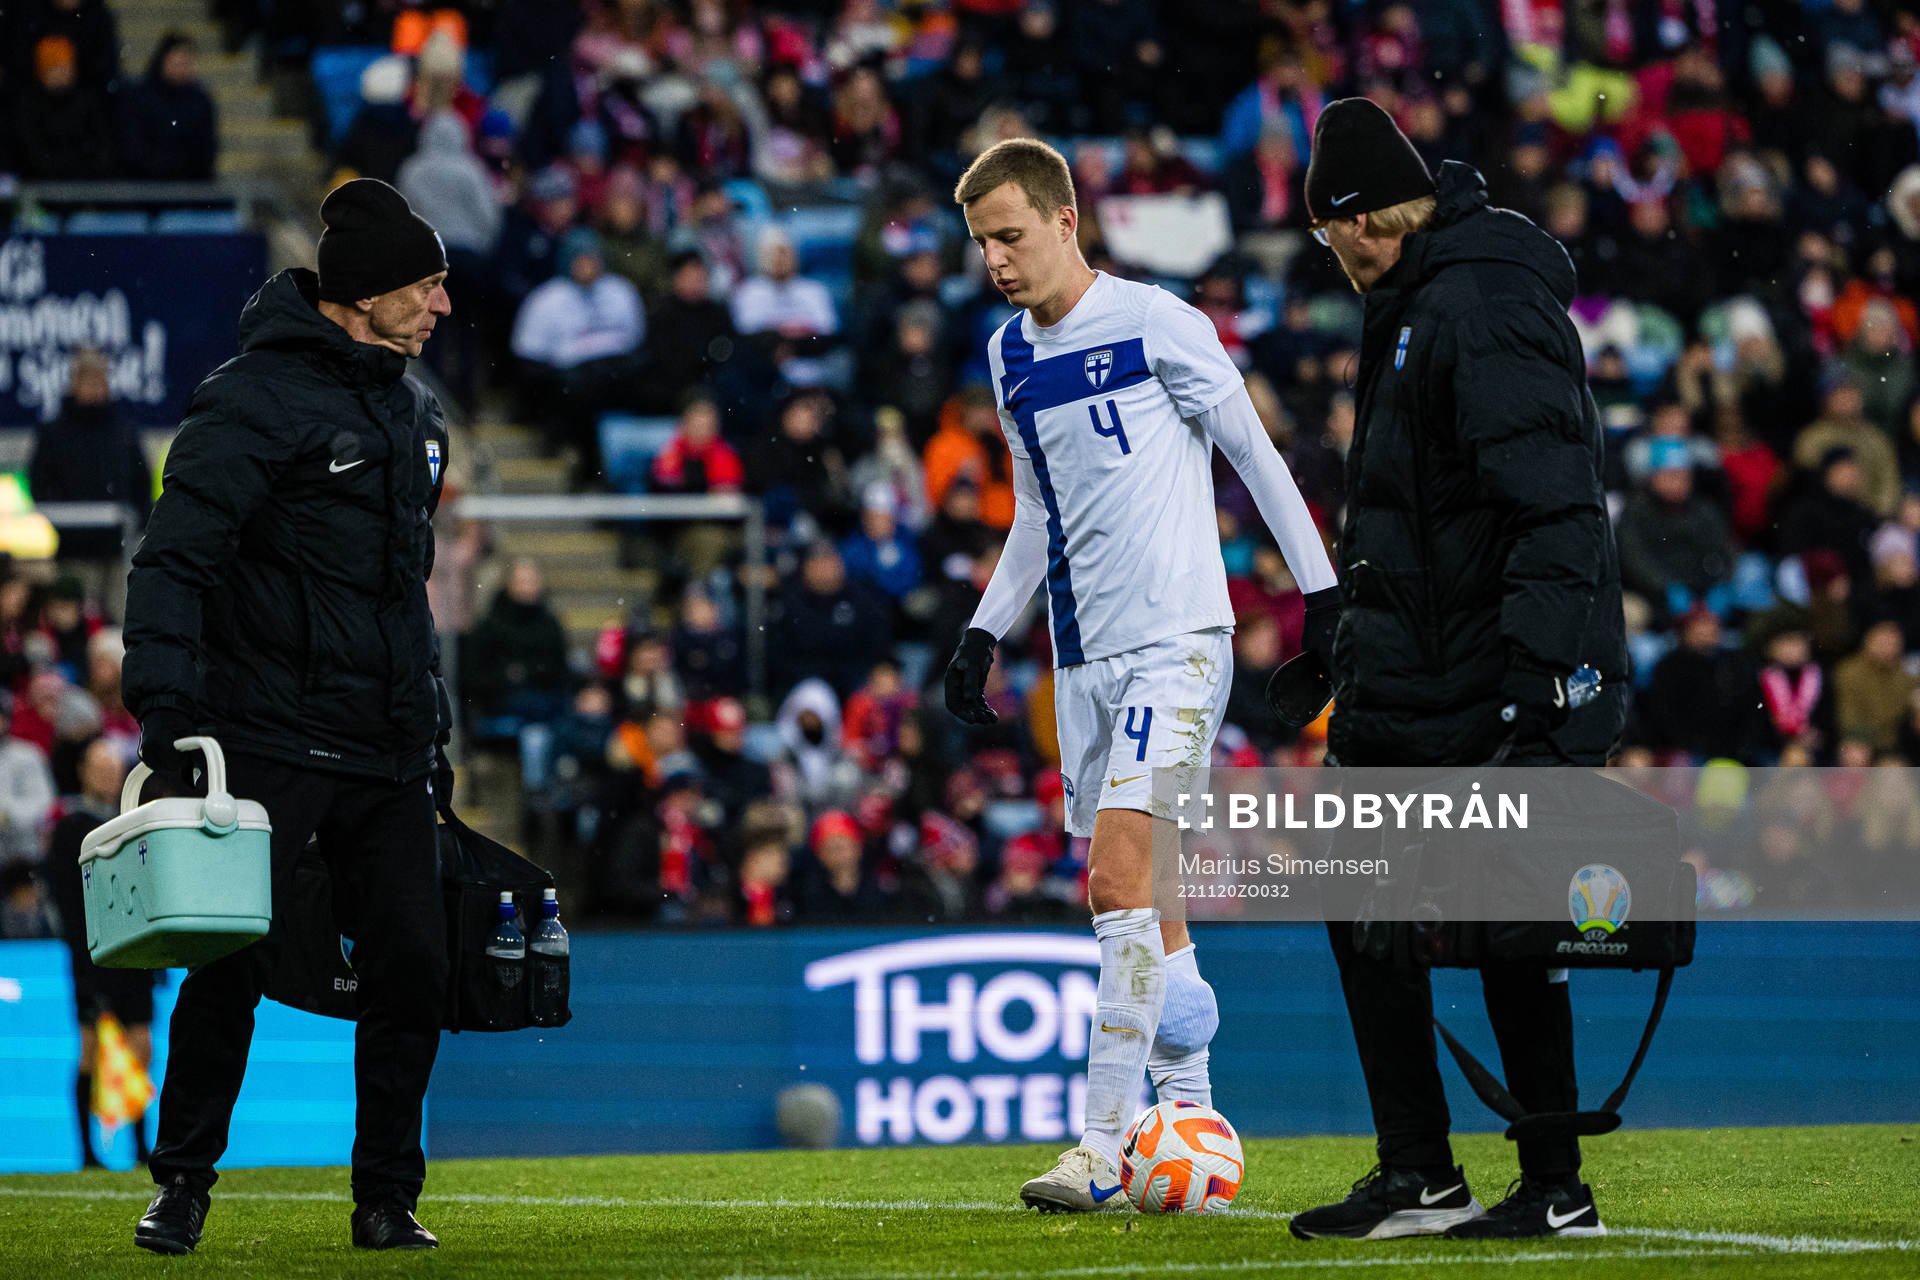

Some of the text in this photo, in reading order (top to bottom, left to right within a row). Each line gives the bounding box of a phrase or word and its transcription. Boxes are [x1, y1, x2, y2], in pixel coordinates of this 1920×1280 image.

[1088, 399, 1132, 456] 4
[1124, 706, 1153, 762] 4
[855, 1075, 1152, 1144] HOTE
